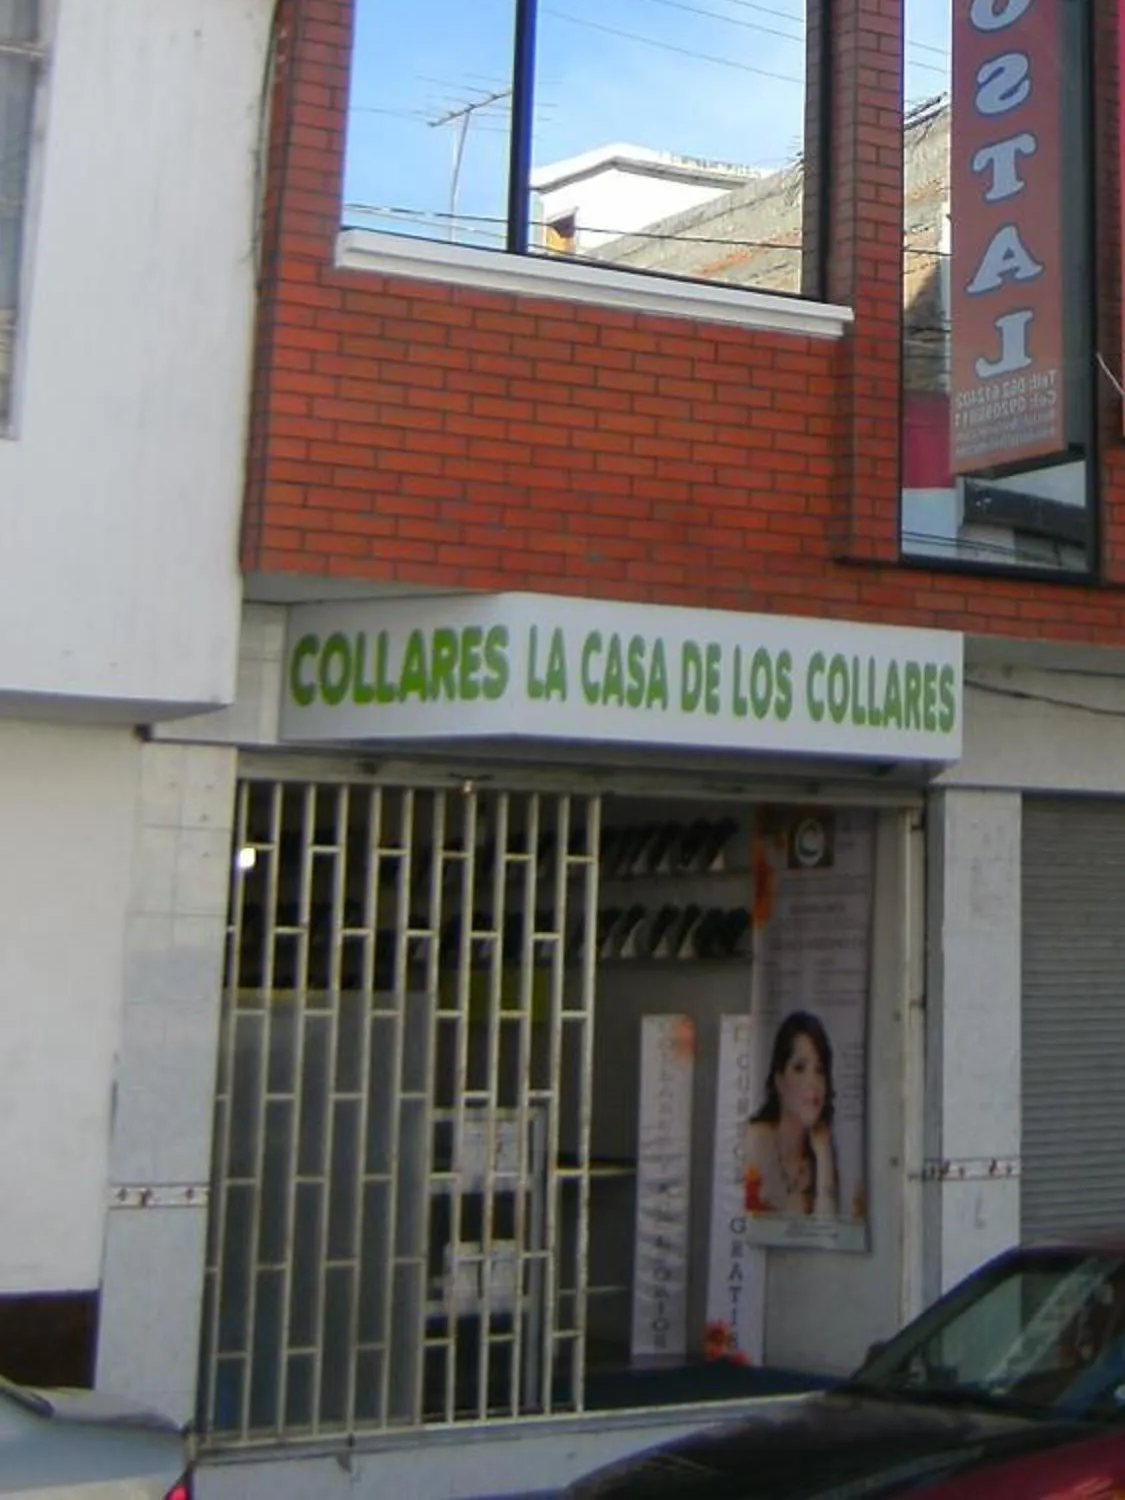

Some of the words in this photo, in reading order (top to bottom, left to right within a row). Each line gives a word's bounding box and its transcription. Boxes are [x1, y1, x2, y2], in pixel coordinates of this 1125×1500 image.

[289, 624, 510, 708] COLLARES
[525, 624, 568, 703] LA
[580, 631, 669, 712] CASA
[680, 640, 721, 715] DE
[731, 643, 793, 722] LOS
[806, 650, 955, 734] COLLARES
